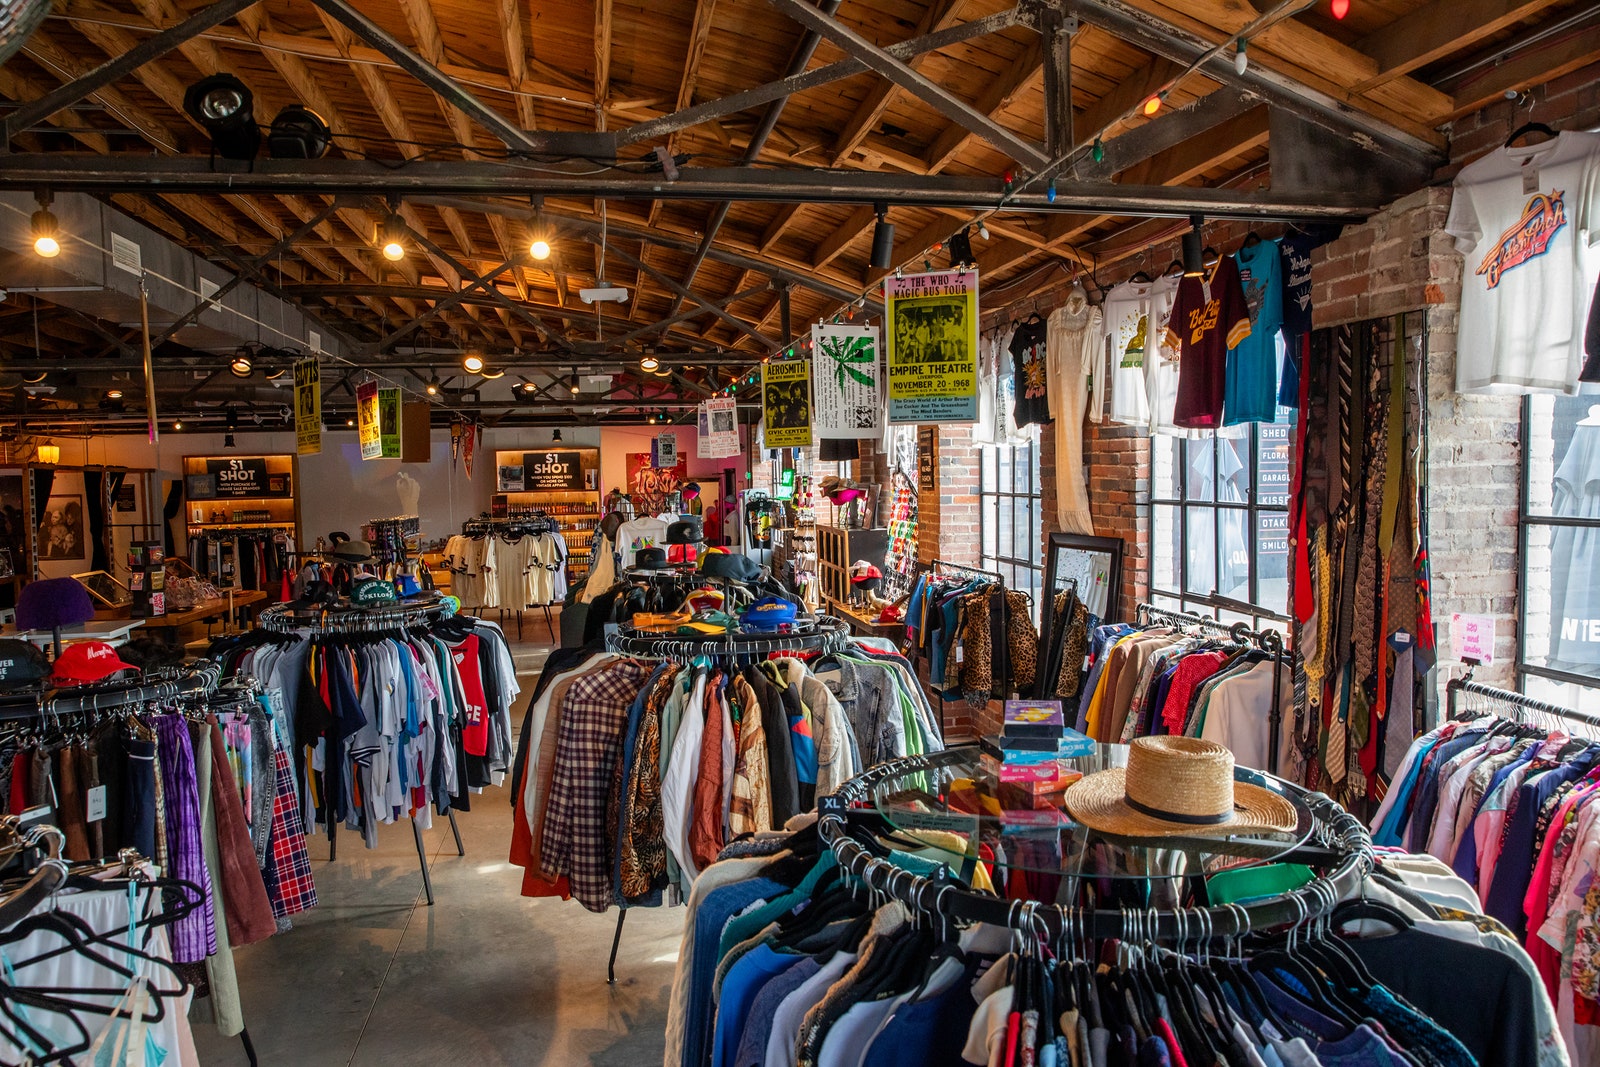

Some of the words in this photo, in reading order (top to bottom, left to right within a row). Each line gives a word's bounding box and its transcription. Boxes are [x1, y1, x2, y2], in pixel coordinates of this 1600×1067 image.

[911, 277, 926, 288] THE
[930, 275, 949, 286] WHO
[894, 287, 920, 299] MAGIC
[923, 286, 940, 297] BUS
[944, 284, 967, 295] TOUR
[767, 363, 805, 375] AEROSMITH
[889, 365, 924, 376] EMPIRE
[928, 363, 973, 374] THEATRE
[893, 380, 933, 390] NOVEMBER
[937, 380, 947, 388] 20
[953, 379, 970, 387] 1968
[1262, 429, 1286, 438] SHED
[545, 452, 559, 464] $1
[1262, 451, 1288, 460] FLORA
[229, 459, 243, 470] $1
[534, 463, 569, 474] SHOT
[220, 469, 255, 481] SHOT
[1262, 495, 1291, 504] KISSE
[1262, 519, 1288, 528] OTAK
[1262, 541, 1289, 550] SMILO
[824, 799, 841, 809] XL
[938, 867, 945, 880] S
